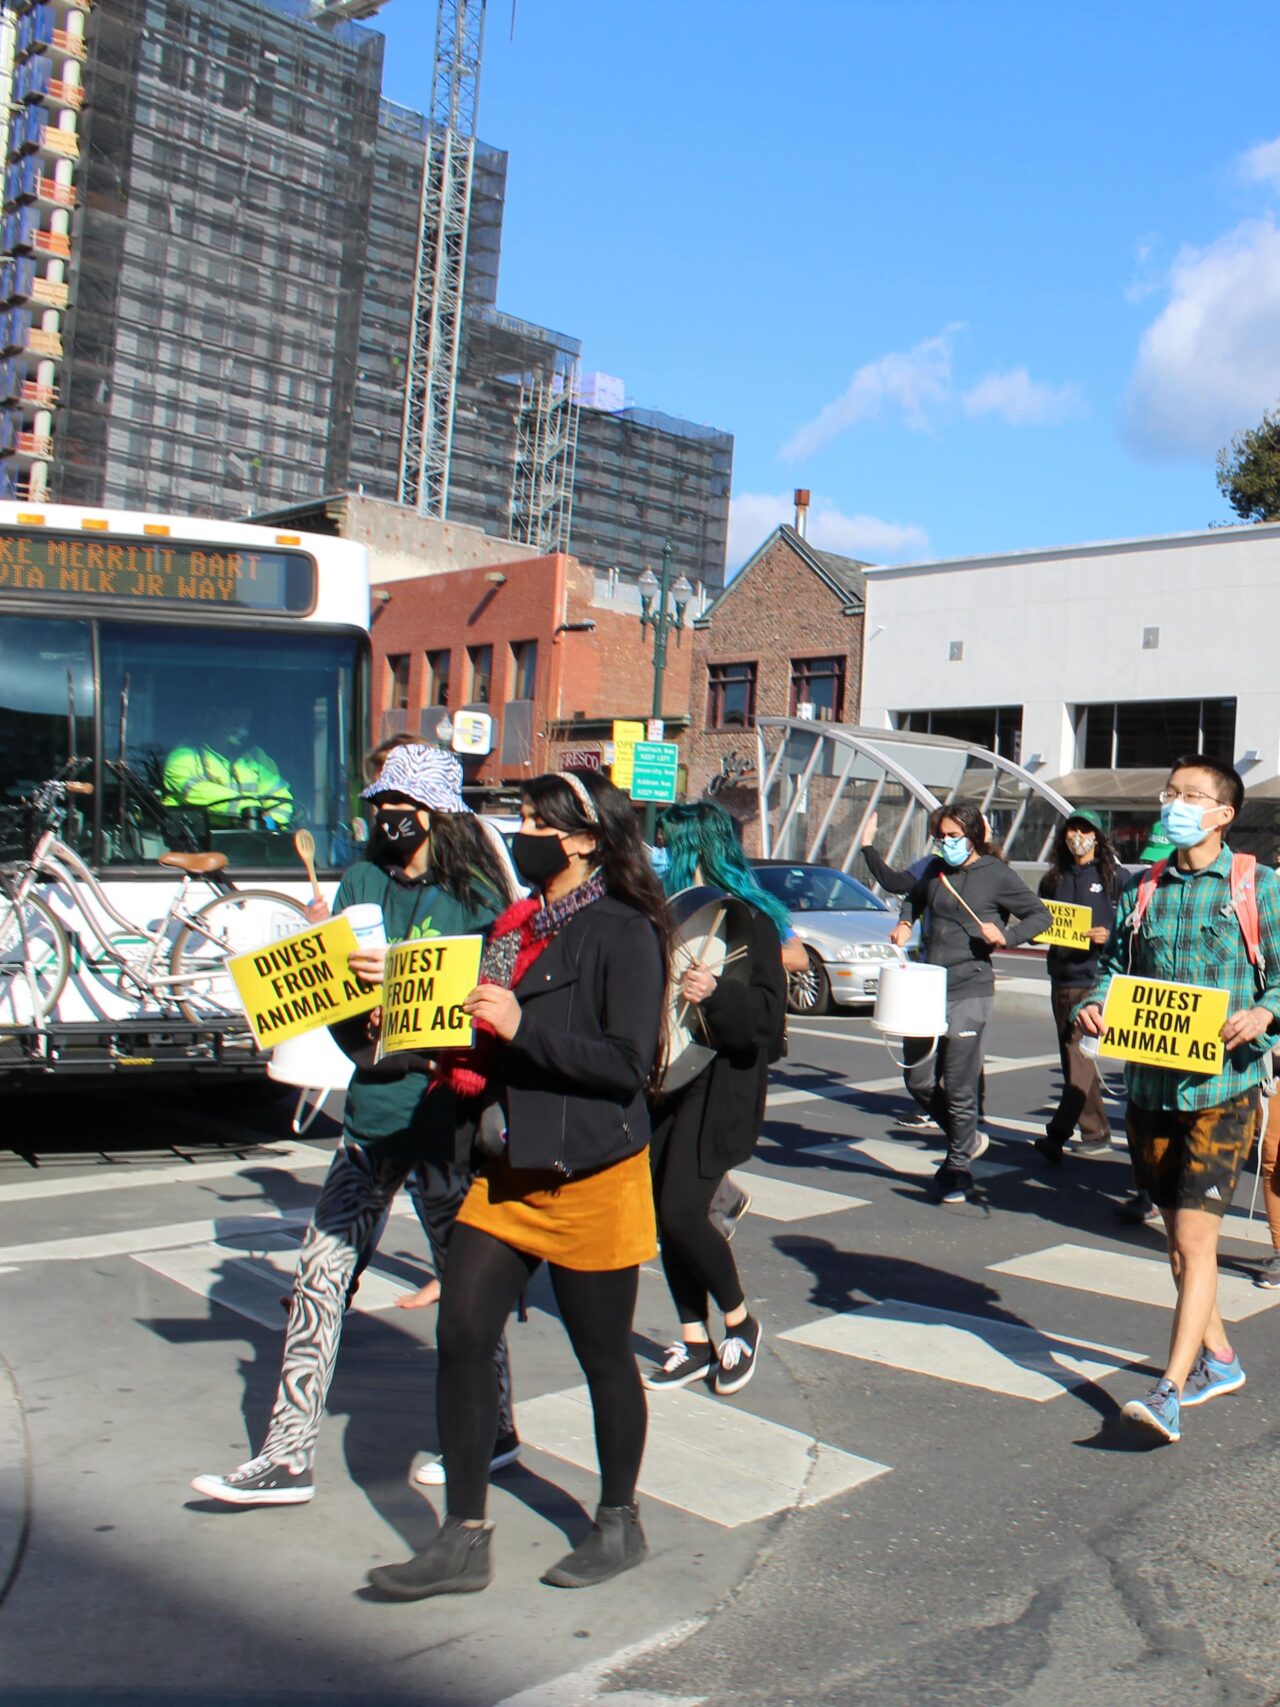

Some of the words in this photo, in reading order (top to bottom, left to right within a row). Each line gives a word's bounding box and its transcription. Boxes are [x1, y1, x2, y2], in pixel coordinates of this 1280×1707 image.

[0, 536, 32, 564] KE
[47, 540, 176, 574] MERRITT
[190, 551, 262, 580] BART
[60, 567, 117, 593] MLK
[131, 574, 164, 597] JR
[177, 576, 237, 600] WAY
[560, 750, 599, 771] FRESCO
[1046, 903, 1076, 918] IVEST
[1055, 917, 1072, 928] OM
[253, 932, 327, 977] DIVEST
[271, 962, 335, 999] FROM
[387, 978, 434, 1008] FROM
[255, 992, 340, 1035] ANIMAL
[1131, 985, 1202, 1012] DIVEST
[385, 1007, 422, 1037] IMAL
[431, 1004, 465, 1031] AG
[1133, 1008, 1191, 1034] FROM
[1103, 1026, 1180, 1056] ANIMAL
[1187, 1040, 1217, 1061] AG
